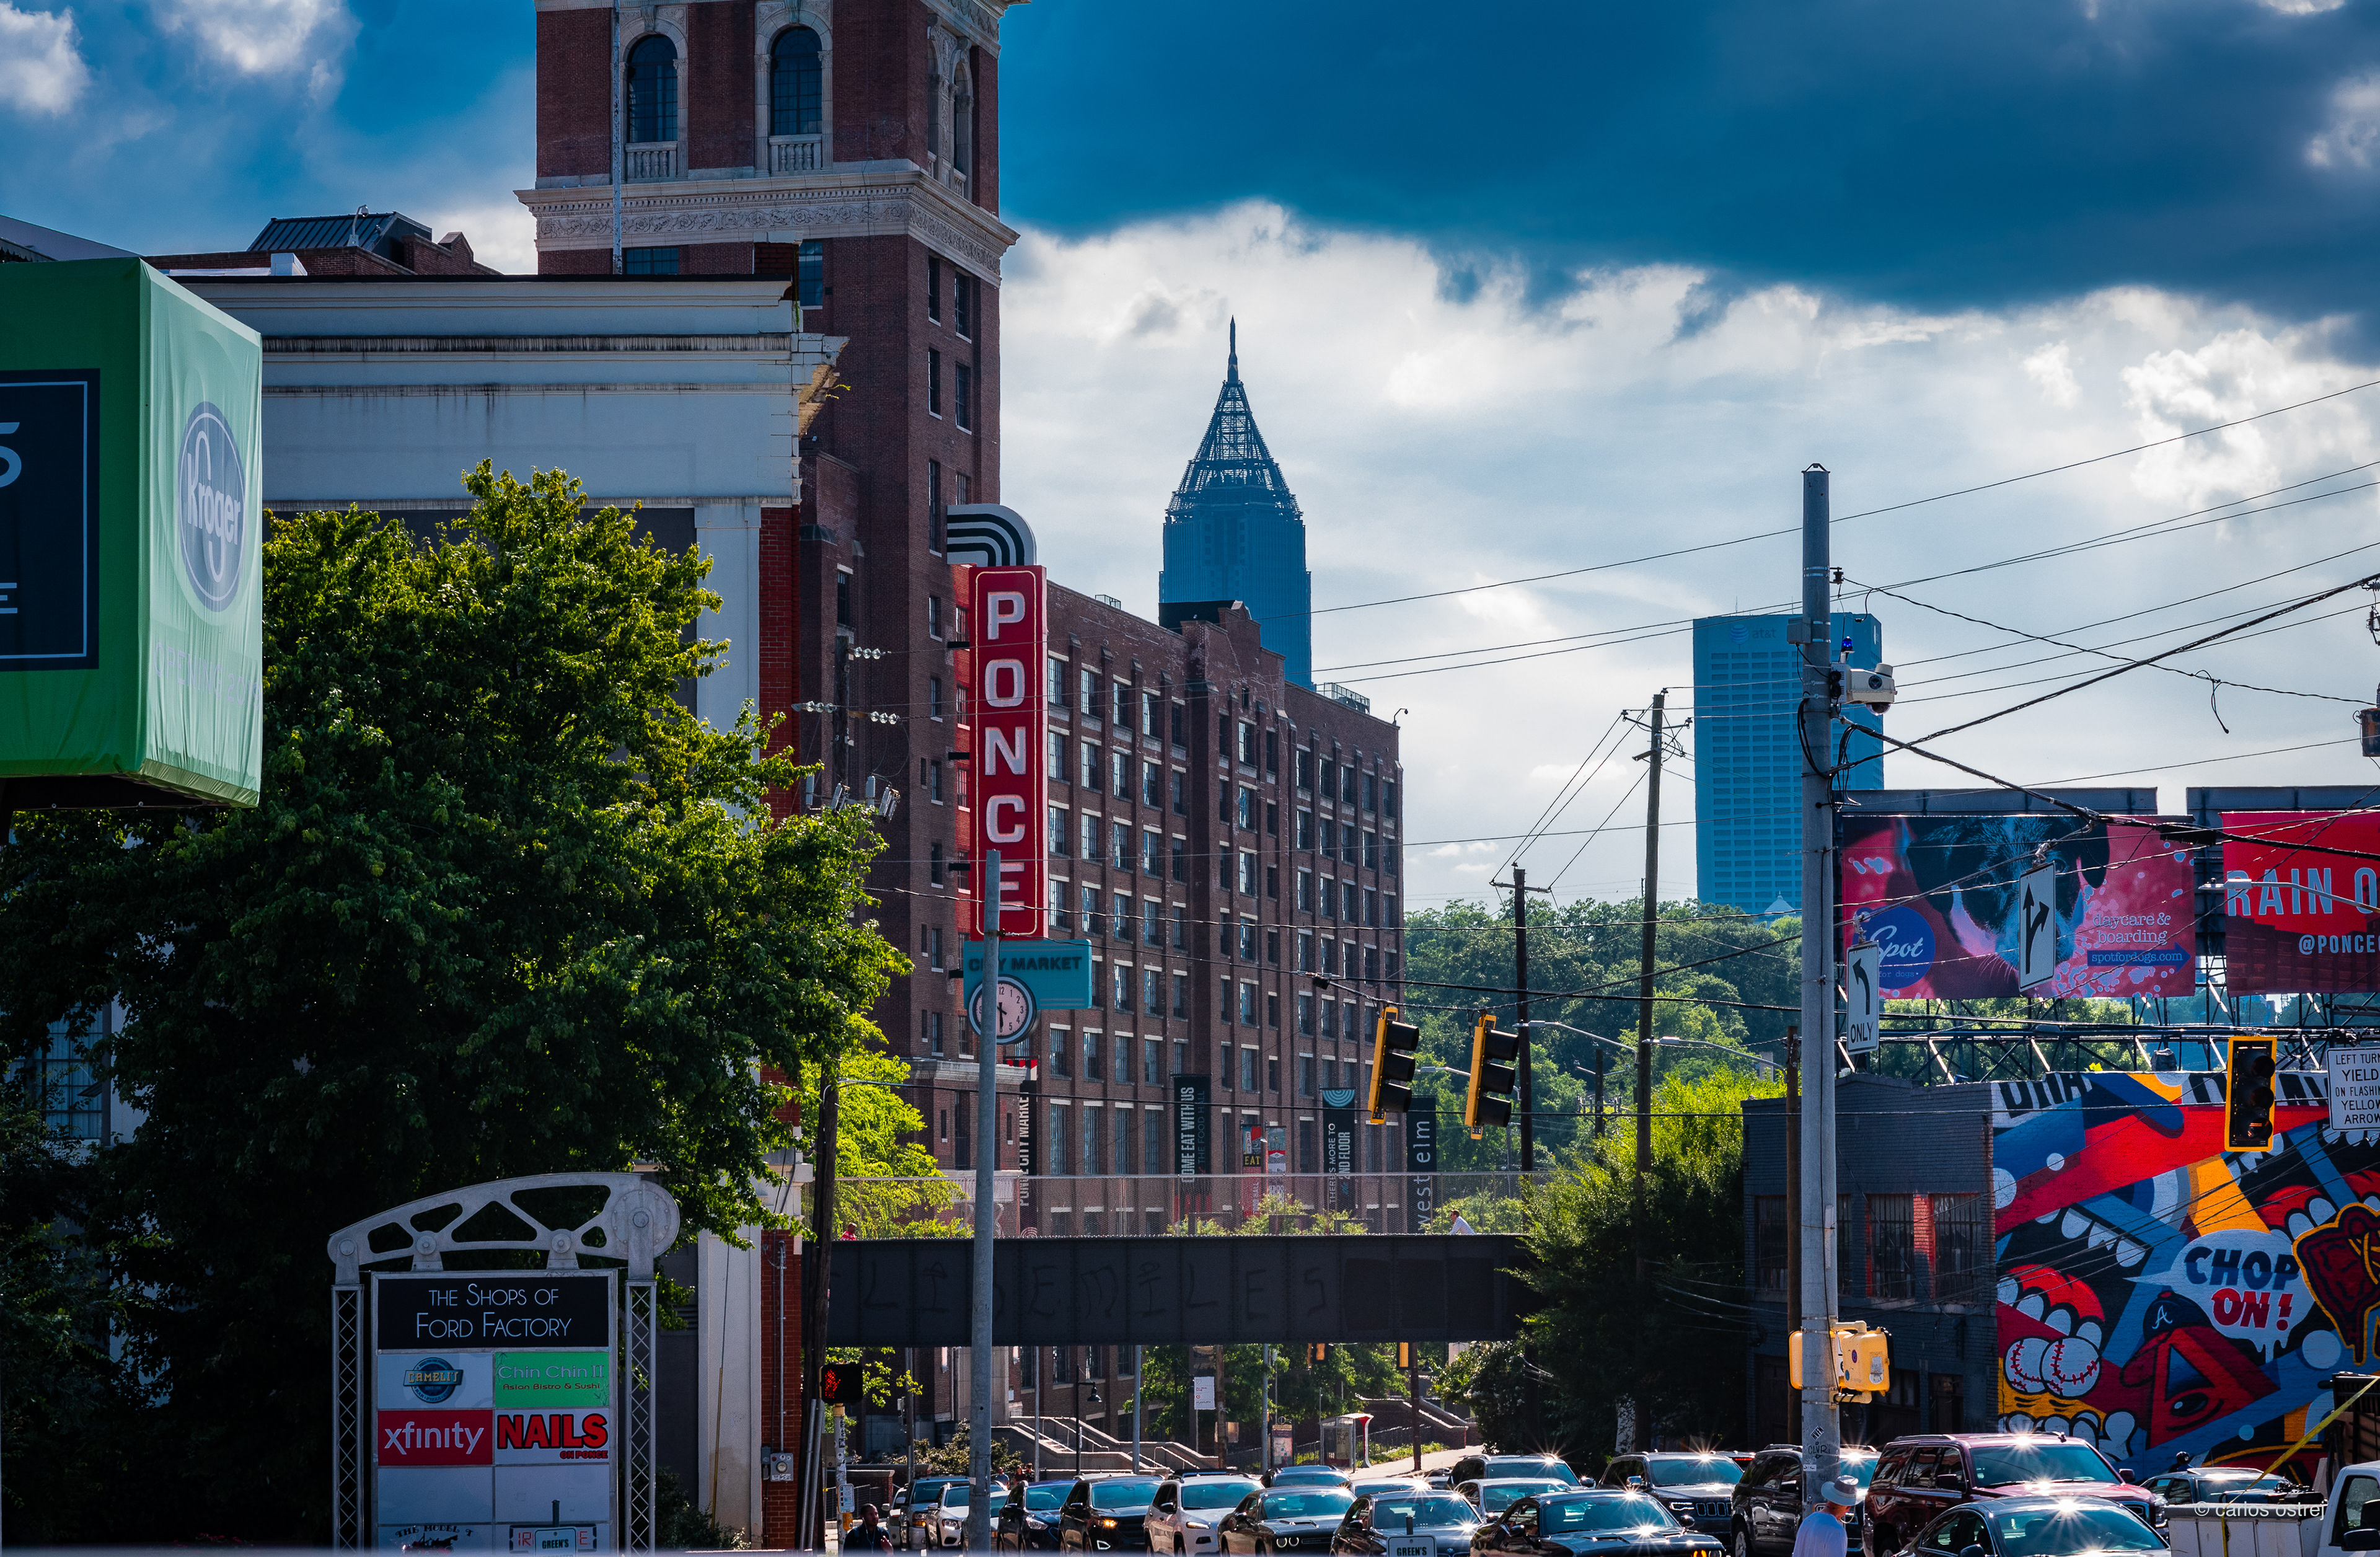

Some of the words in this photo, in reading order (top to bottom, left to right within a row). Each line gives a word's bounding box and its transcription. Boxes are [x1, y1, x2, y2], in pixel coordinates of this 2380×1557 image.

[188, 431, 241, 583] Kroger
[1752, 627, 1777, 638] at&t
[154, 642, 222, 698] OPENING
[984, 591, 1026, 911] PONCE
[2227, 868, 2332, 916] RAIN
[2092, 913, 2155, 929] daycare
[2157, 912, 2171, 925] &
[1869, 925, 1923, 966] Spot
[2097, 930, 2167, 945] boarding
[2299, 934, 2380, 955] @PONCE
[969, 958, 1007, 971] CIY
[1011, 956, 1082, 971] MARKET
[2092, 952, 2183, 964] spotfordogs.com
[1895, 971, 1915, 979] dogs
[998, 986, 1005, 995] 12
[1850, 1022, 1874, 1044] ONLY
[2336, 1054, 2356, 1065] LEFT
[2342, 1069, 2379, 1082] YIELD
[1181, 1087, 1194, 1101] US
[2335, 1087, 2345, 1096] ON
[1181, 1104, 1194, 1131] WITH
[1328, 1123, 1335, 1135] TO
[1181, 1133, 1194, 1150] EAT
[1338, 1132, 1350, 1159] FLOOR
[1413, 1121, 1430, 1163] elm
[1245, 1156, 1260, 1165] EAT
[1413, 1175, 1432, 1231] west
[2184, 1246, 2301, 1290] CHOP
[429, 1290, 457, 1306] THE
[467, 1284, 527, 1306] SHOPS
[534, 1289, 558, 1305] OF
[416, 1312, 473, 1338] FORD
[483, 1312, 572, 1337] FACTORY
[408, 1371, 459, 1383] CAMELI'S
[498, 1365, 540, 1378] Chin
[545, 1365, 588, 1378] Chin
[591, 1365, 605, 1378] II
[384, 1421, 484, 1455] xfinity
[497, 1413, 608, 1449] NAILS
[560, 1450, 574, 1459] ON
[575, 1450, 609, 1459] PONCE
[395, 1526, 420, 1538] THE
[424, 1525, 460, 1533] MODEL
[465, 1528, 474, 1537] T
[542, 1539, 570, 1550] GREEN'S
[1396, 1546, 1427, 1557] GREEN'S
